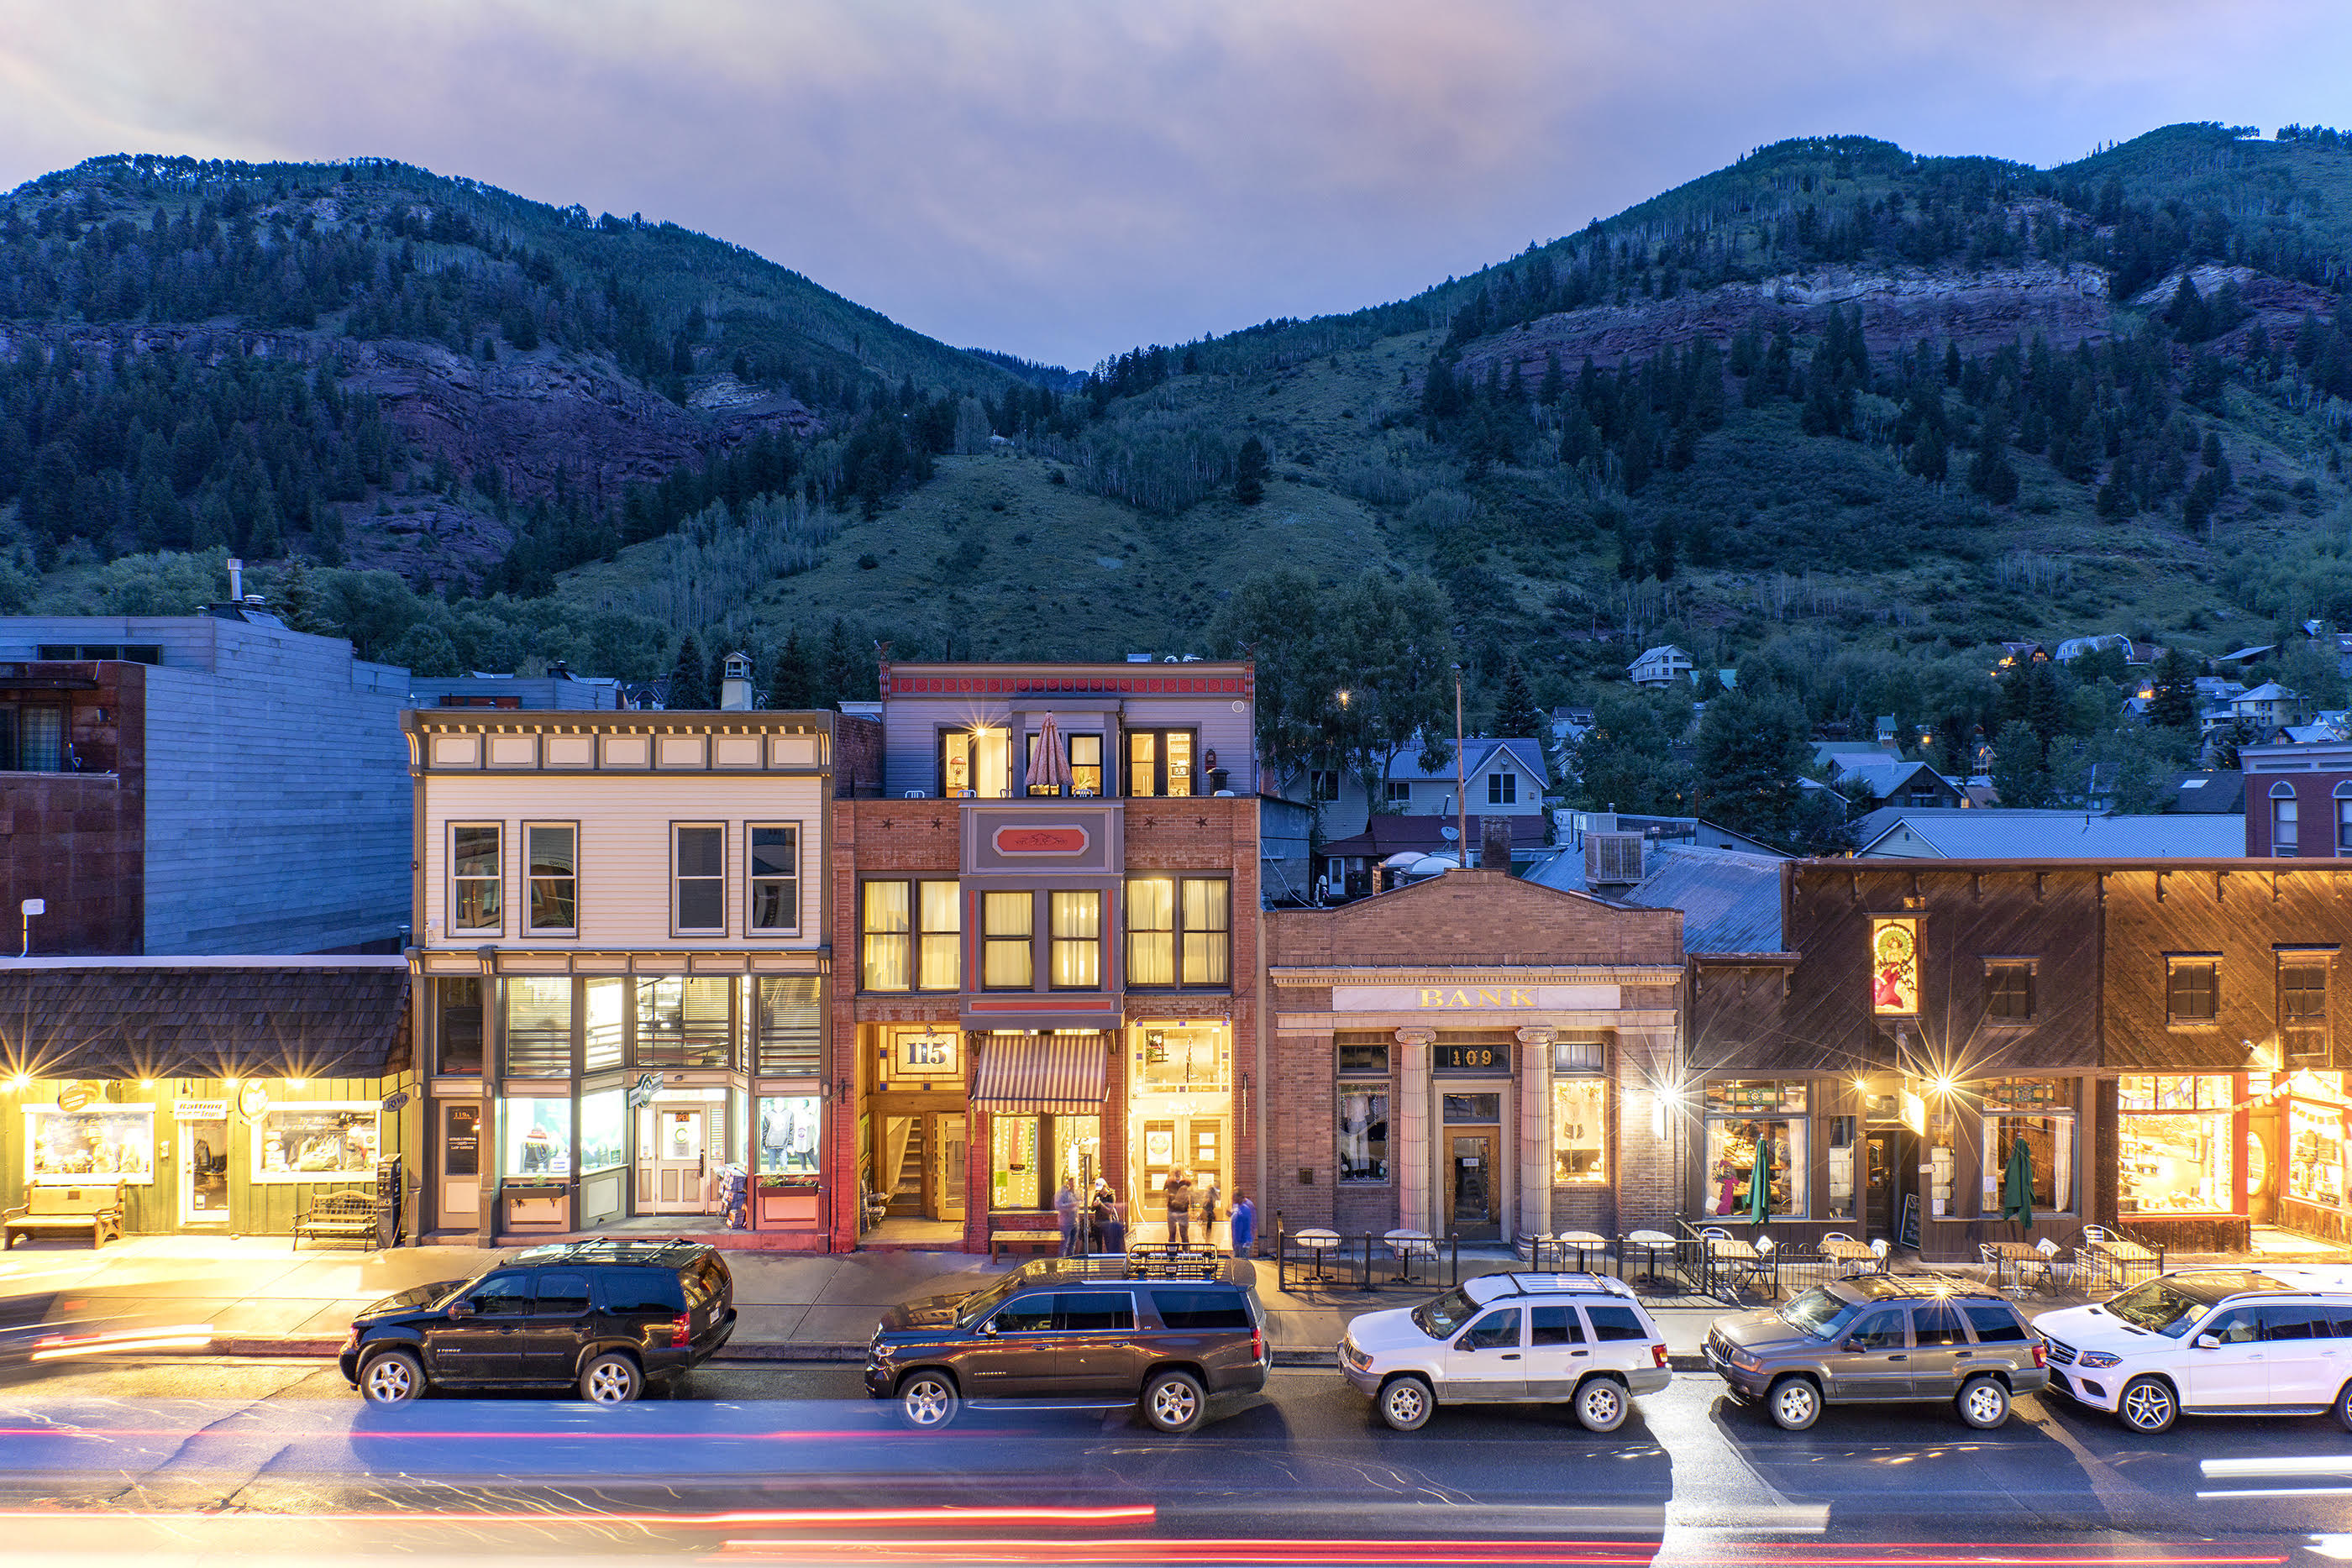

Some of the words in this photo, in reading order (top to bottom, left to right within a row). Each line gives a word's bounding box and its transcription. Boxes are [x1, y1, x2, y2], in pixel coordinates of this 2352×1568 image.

[1418, 989, 1537, 1007] BANK
[907, 1042, 947, 1064] 115
[1452, 1050, 1493, 1066] 109
